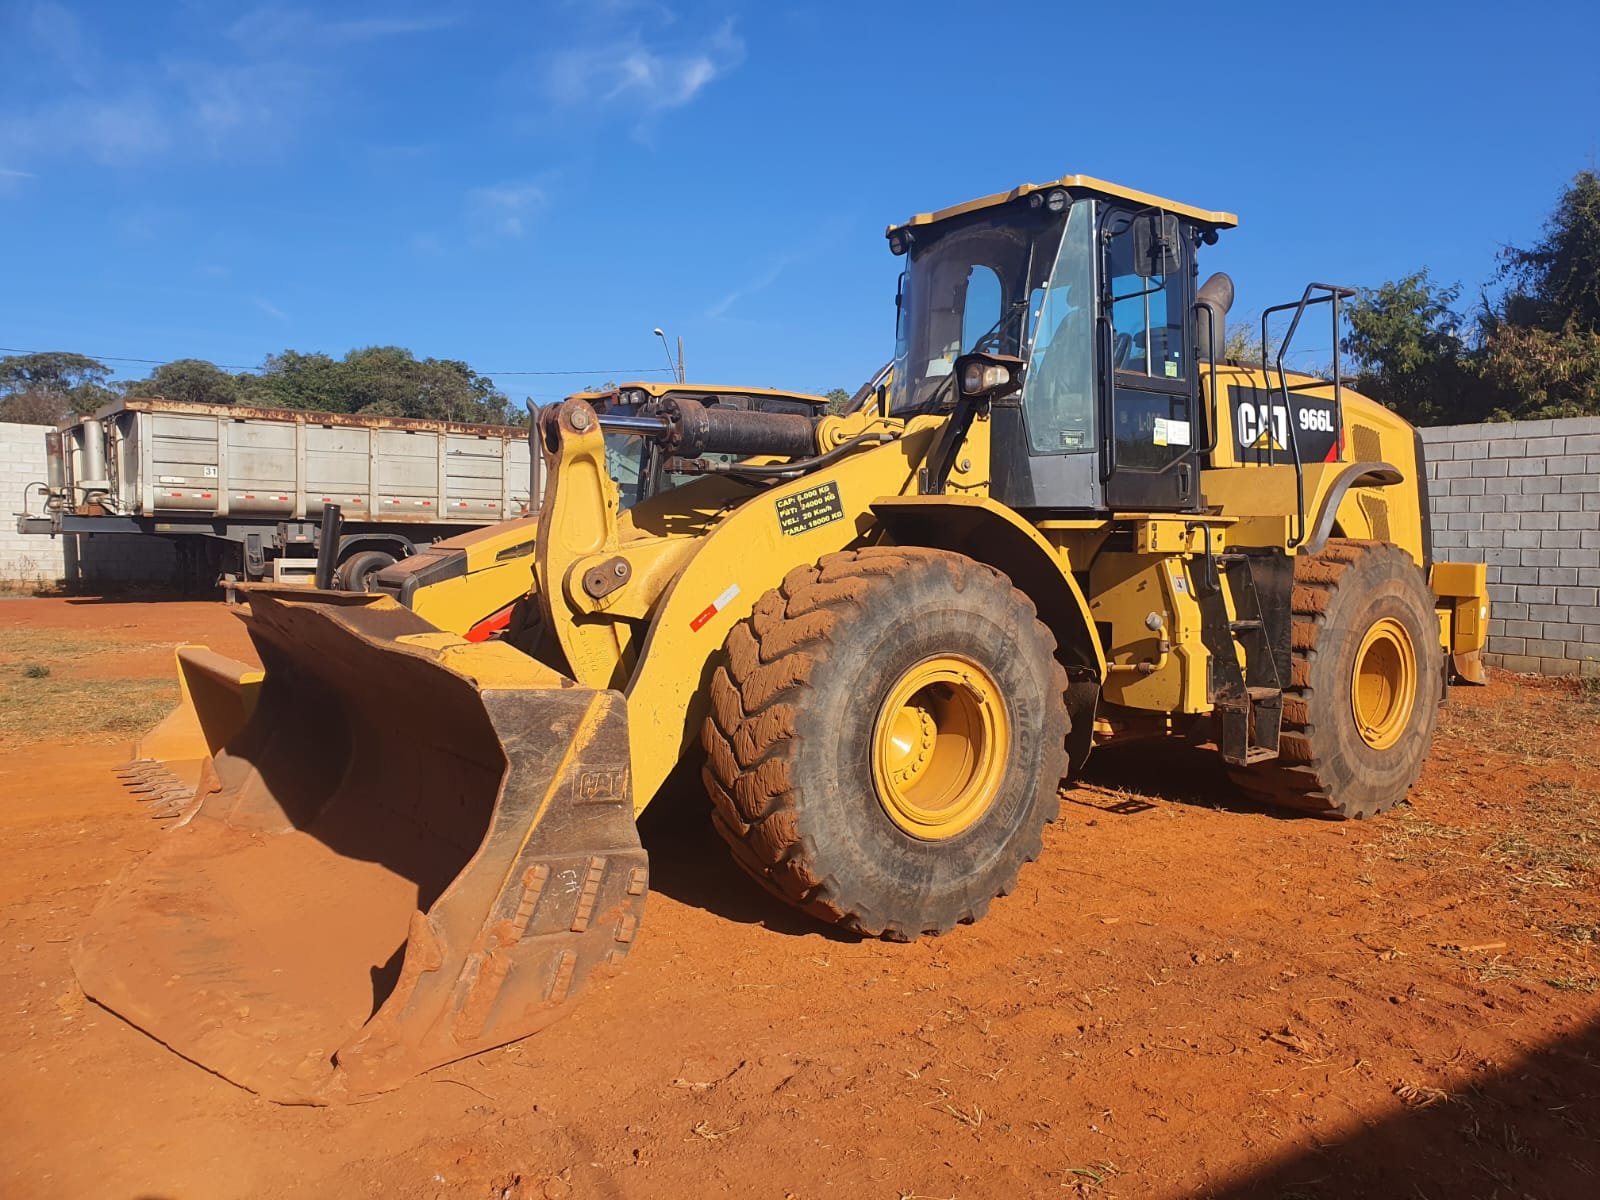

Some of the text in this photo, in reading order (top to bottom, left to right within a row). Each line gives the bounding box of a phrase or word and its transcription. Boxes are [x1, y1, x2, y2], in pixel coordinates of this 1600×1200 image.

[1237, 402, 1334, 451] CAT 966L
[205, 467, 216, 476] 31
[777, 498, 795, 508] CAP:
[818, 486, 829, 494] KG
[824, 493, 835, 502] KG
[782, 517, 799, 526] VEL:
[783, 524, 807, 535] TARA:
[831, 511, 842, 519] KG
